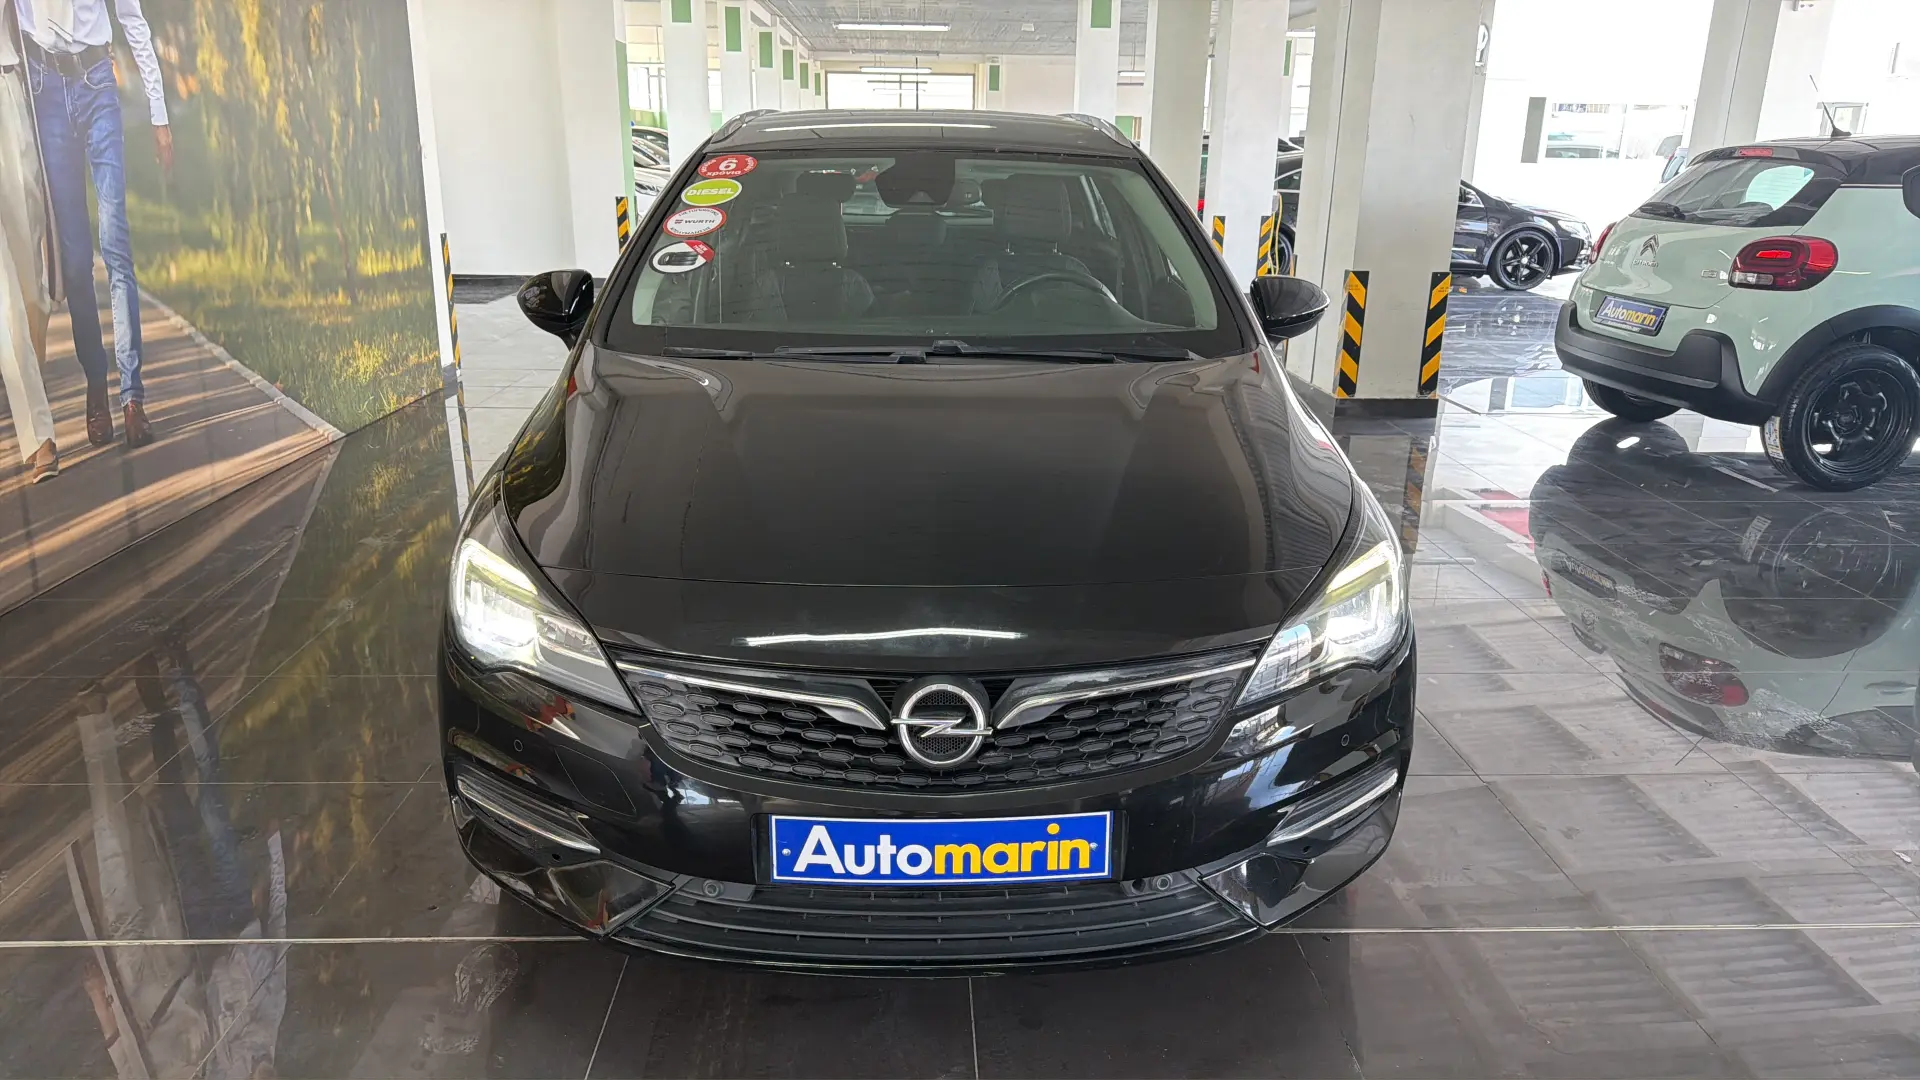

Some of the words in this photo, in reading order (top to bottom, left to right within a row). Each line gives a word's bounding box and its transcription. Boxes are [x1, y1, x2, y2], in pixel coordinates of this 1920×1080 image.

[718, 159, 738, 171] 6
[687, 187, 735, 196] DIESEL
[1601, 300, 1656, 326] Automarin
[793, 823, 1090, 876] Automarin
